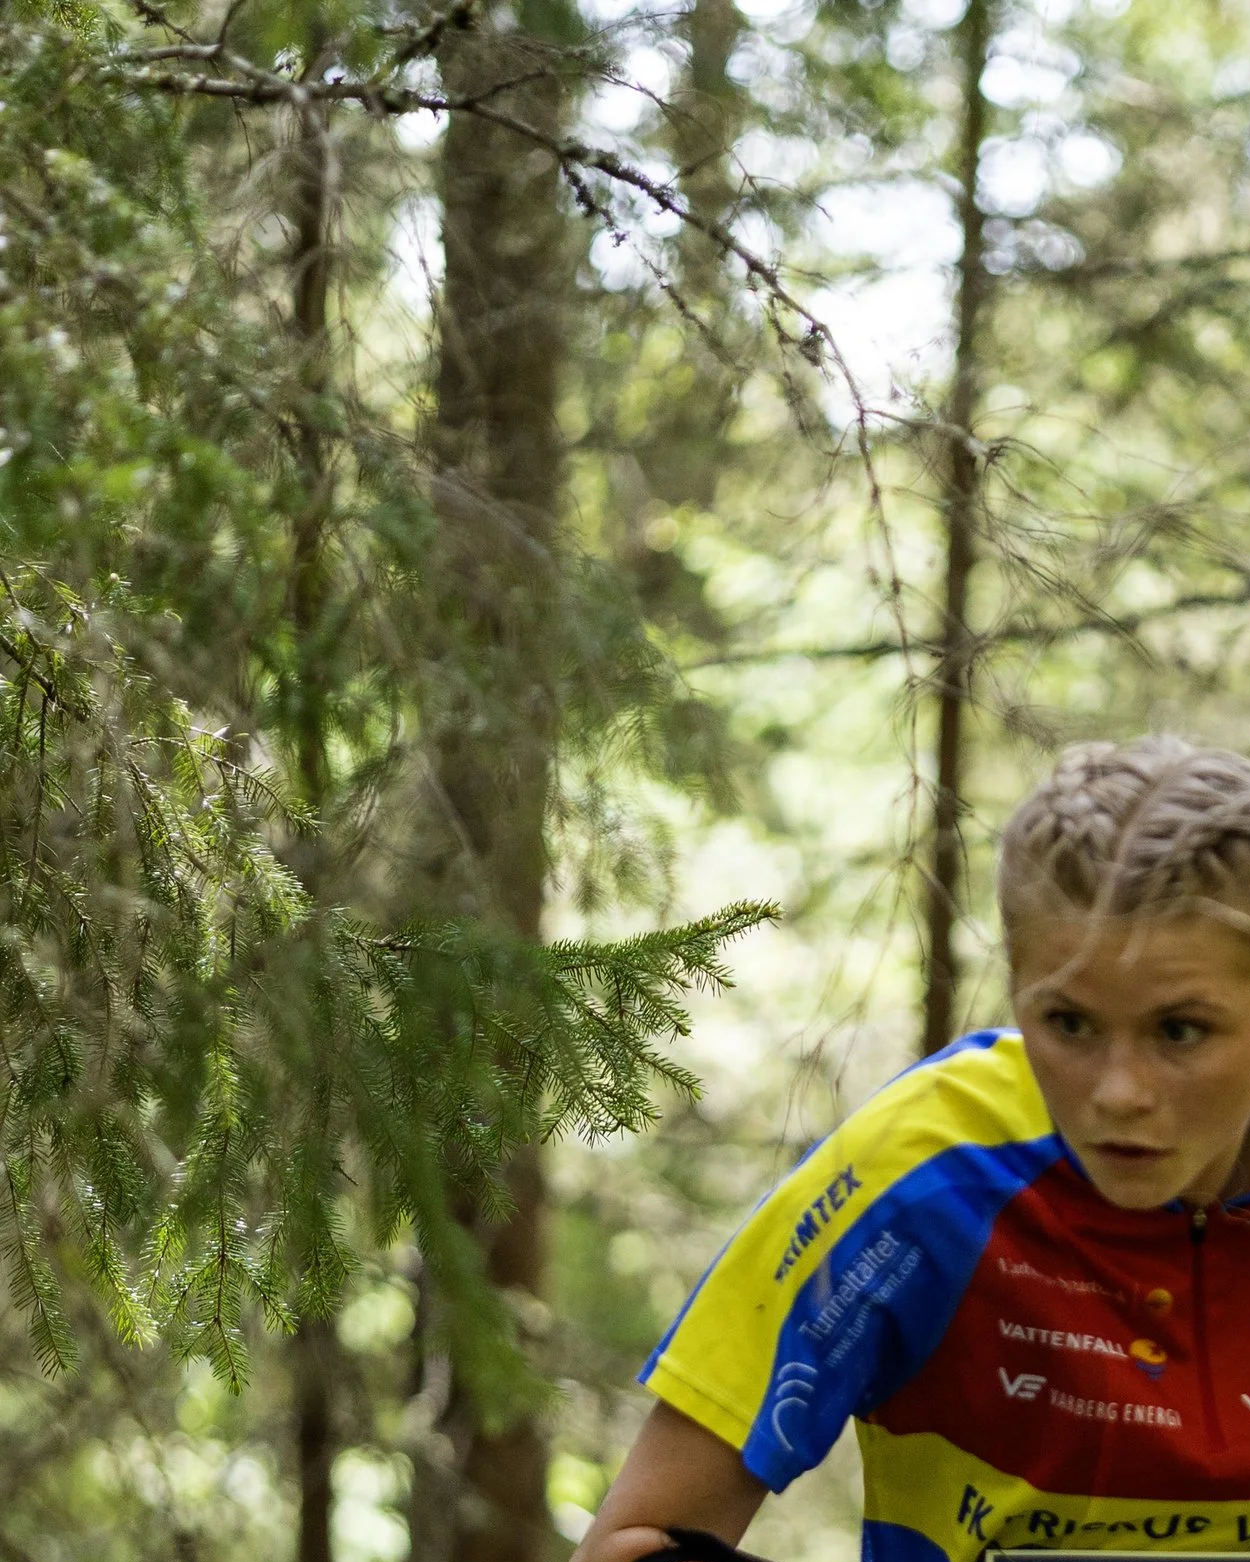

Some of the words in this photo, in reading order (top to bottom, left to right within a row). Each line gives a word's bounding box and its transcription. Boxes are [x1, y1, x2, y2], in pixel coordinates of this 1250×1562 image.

[999, 1318, 1128, 1359] VATTENFALL
[1123, 1402, 1183, 1429] ENERGI
[957, 1483, 993, 1542] FK
